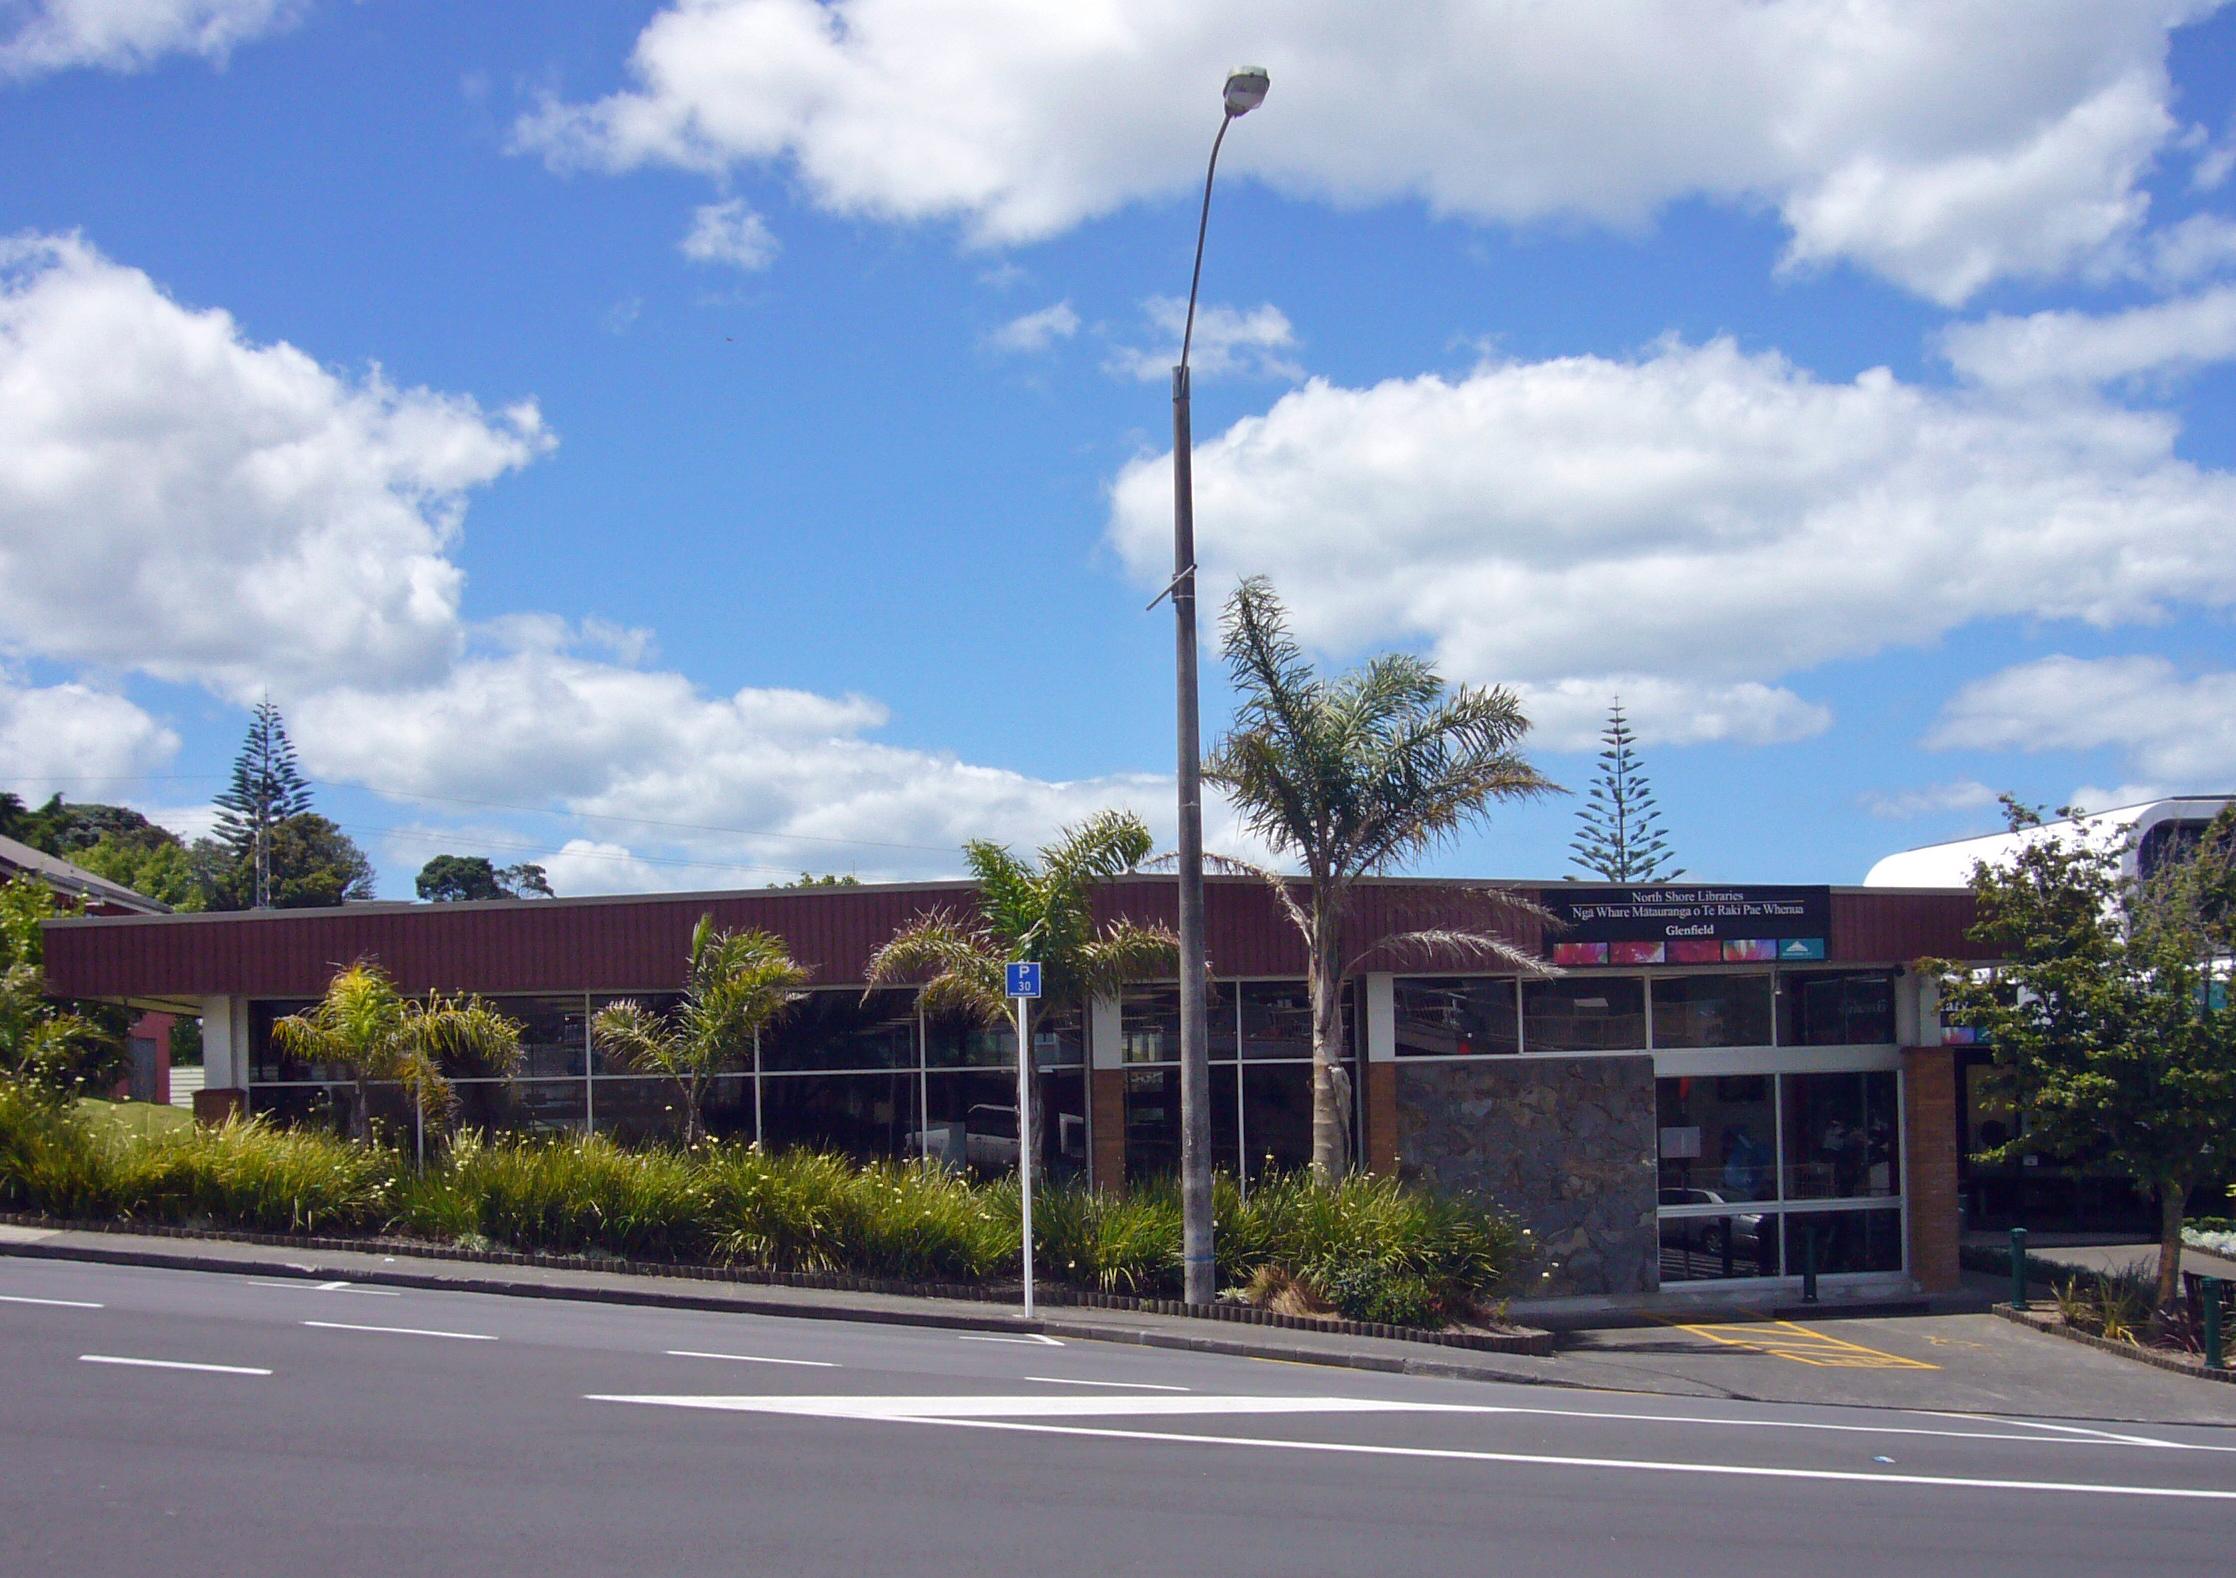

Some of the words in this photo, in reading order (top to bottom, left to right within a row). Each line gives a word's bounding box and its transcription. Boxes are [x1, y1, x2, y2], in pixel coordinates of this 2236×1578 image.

[1632, 890, 1662, 903] North
[1665, 890, 1695, 902] Shore
[1697, 890, 1745, 901] Libraries
[1596, 906, 1630, 917] Whare
[1693, 907, 1701, 916] o
[1702, 905, 1715, 916] Te
[1718, 904, 1741, 915] Raki
[1743, 904, 1761, 915] Pae
[1763, 903, 1804, 914] Whenua
[1665, 924, 1715, 936] Glenfield
[1018, 965, 1030, 979] P
[1018, 981, 1032, 992] 30
